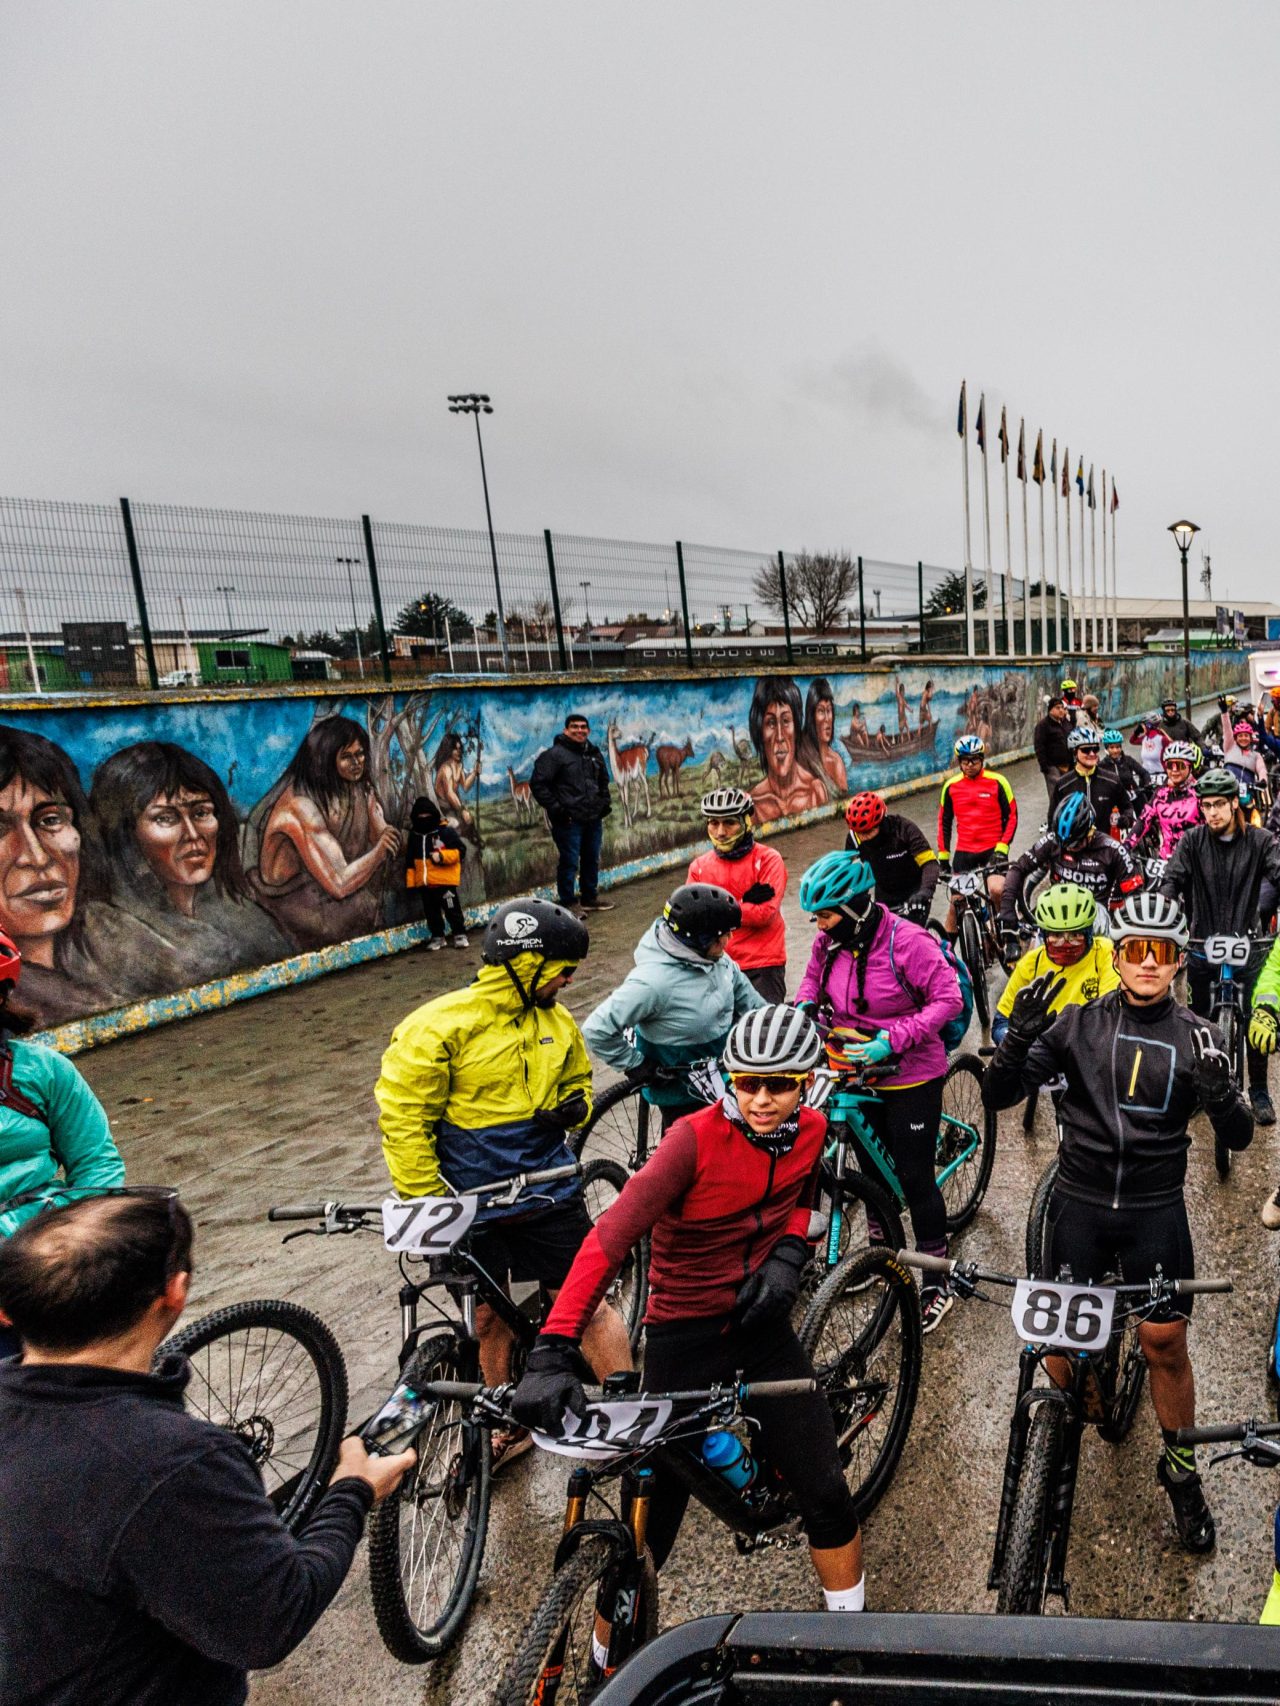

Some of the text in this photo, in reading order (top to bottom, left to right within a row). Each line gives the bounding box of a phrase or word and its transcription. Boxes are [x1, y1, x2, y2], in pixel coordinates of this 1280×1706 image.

[953, 876, 977, 891] 44
[1063, 867, 1108, 884] BORA
[496, 938, 543, 947] THOMPSON
[1212, 941, 1247, 960] 56
[386, 1201, 465, 1248] 72
[1022, 1288, 1104, 1343] 86
